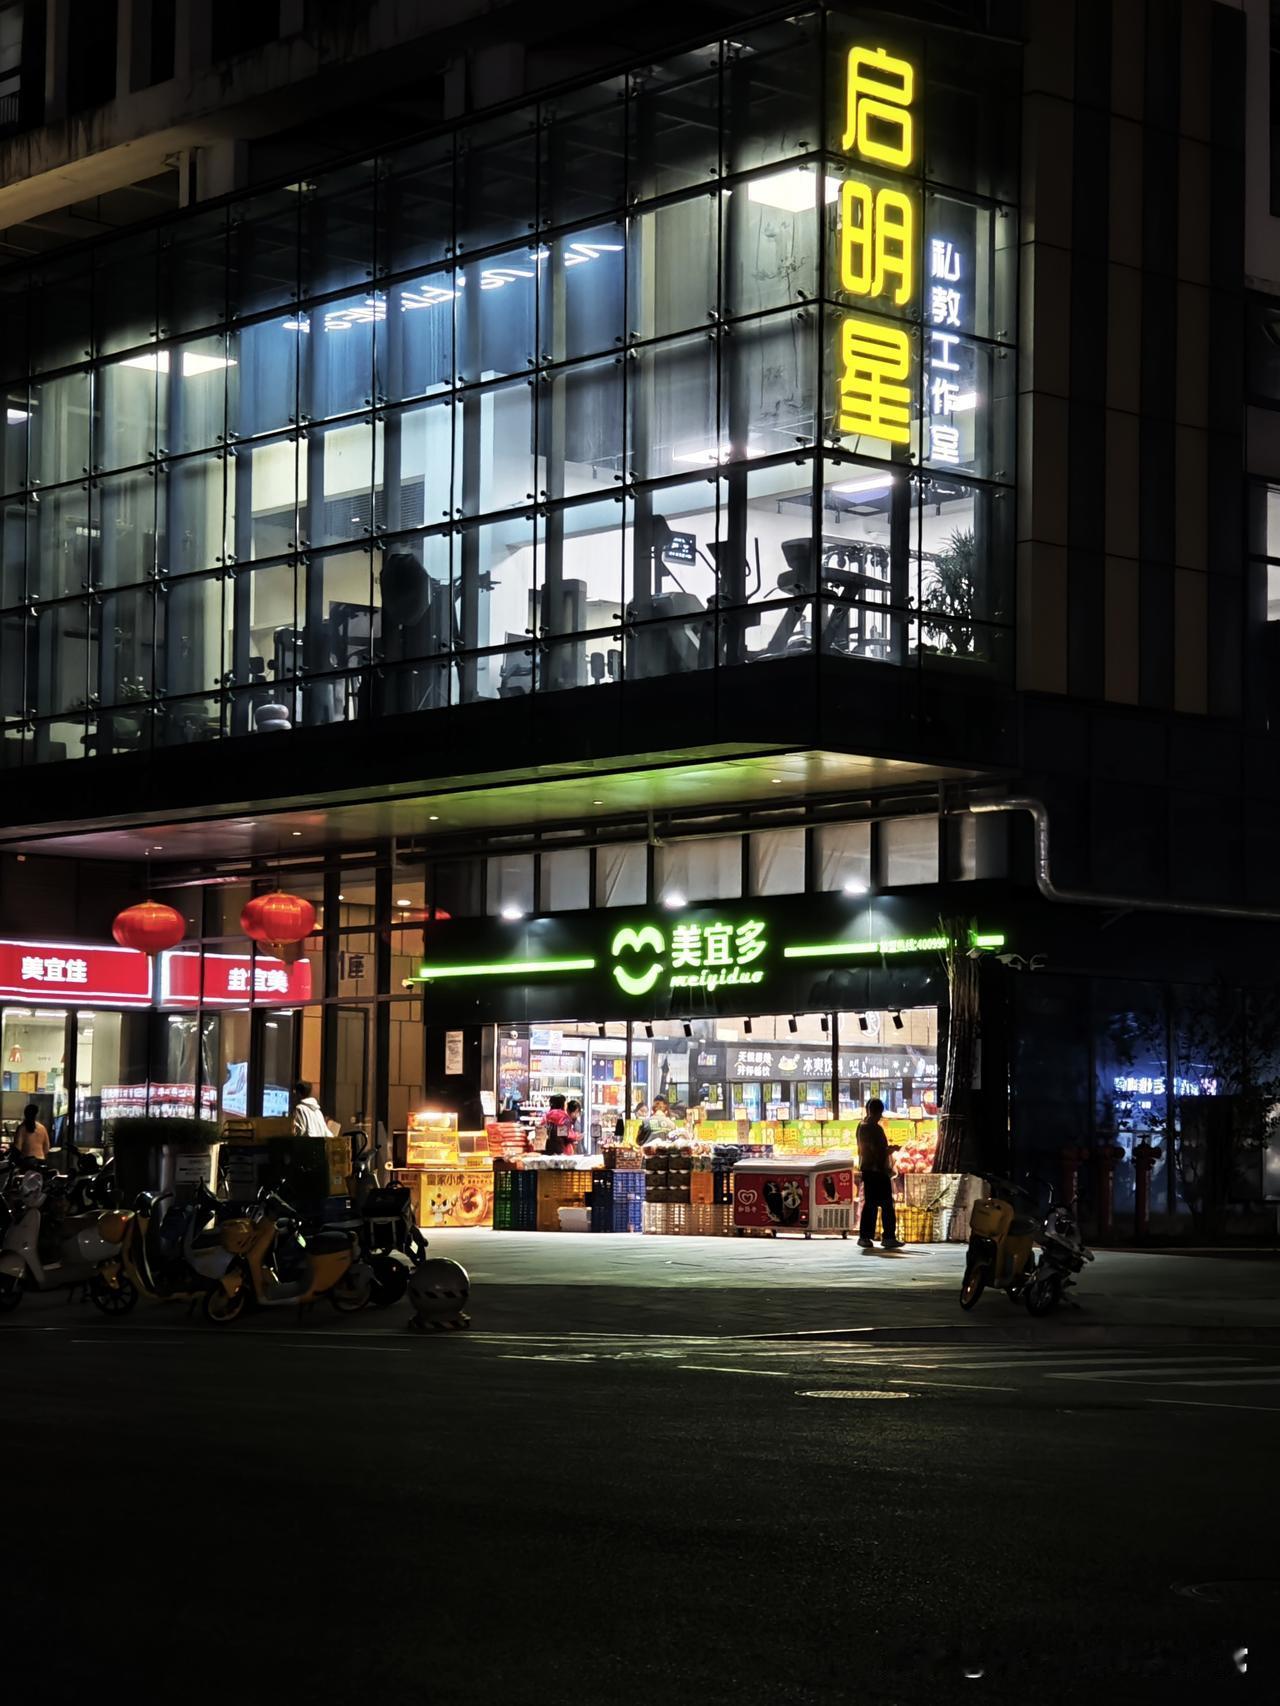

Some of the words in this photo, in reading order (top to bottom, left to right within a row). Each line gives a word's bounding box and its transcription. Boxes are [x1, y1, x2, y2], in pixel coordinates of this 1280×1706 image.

[840, 46, 914, 445] 启明星
[930, 238, 961, 464] 私教工作室
[671, 920, 766, 968] 美宜多
[21, 956, 88, 983] 美宜佳
[669, 966, 764, 991] meiyiduo
